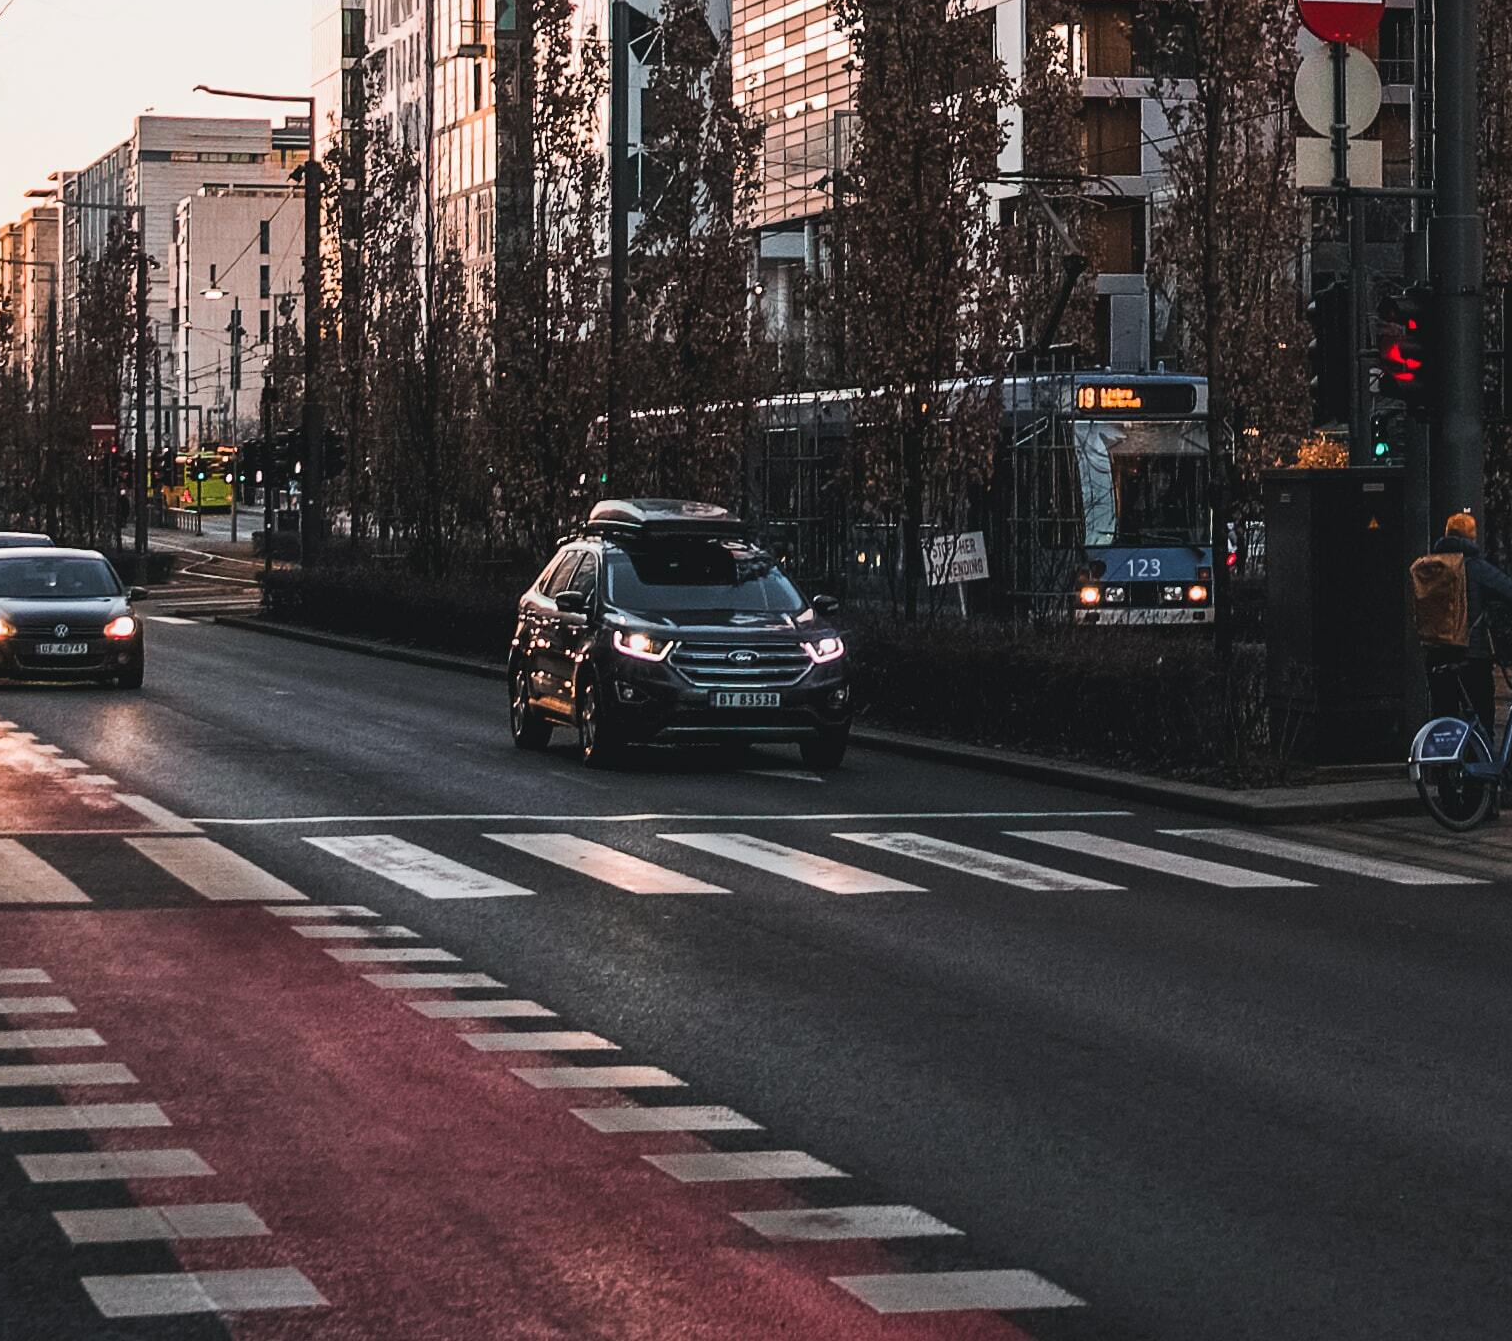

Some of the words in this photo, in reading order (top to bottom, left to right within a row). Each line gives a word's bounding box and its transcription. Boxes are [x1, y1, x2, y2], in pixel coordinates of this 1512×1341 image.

[1079, 387, 1095, 409] 19
[959, 538, 977, 554] HER
[949, 558, 984, 577] ENDING
[1127, 558, 1161, 577] 123
